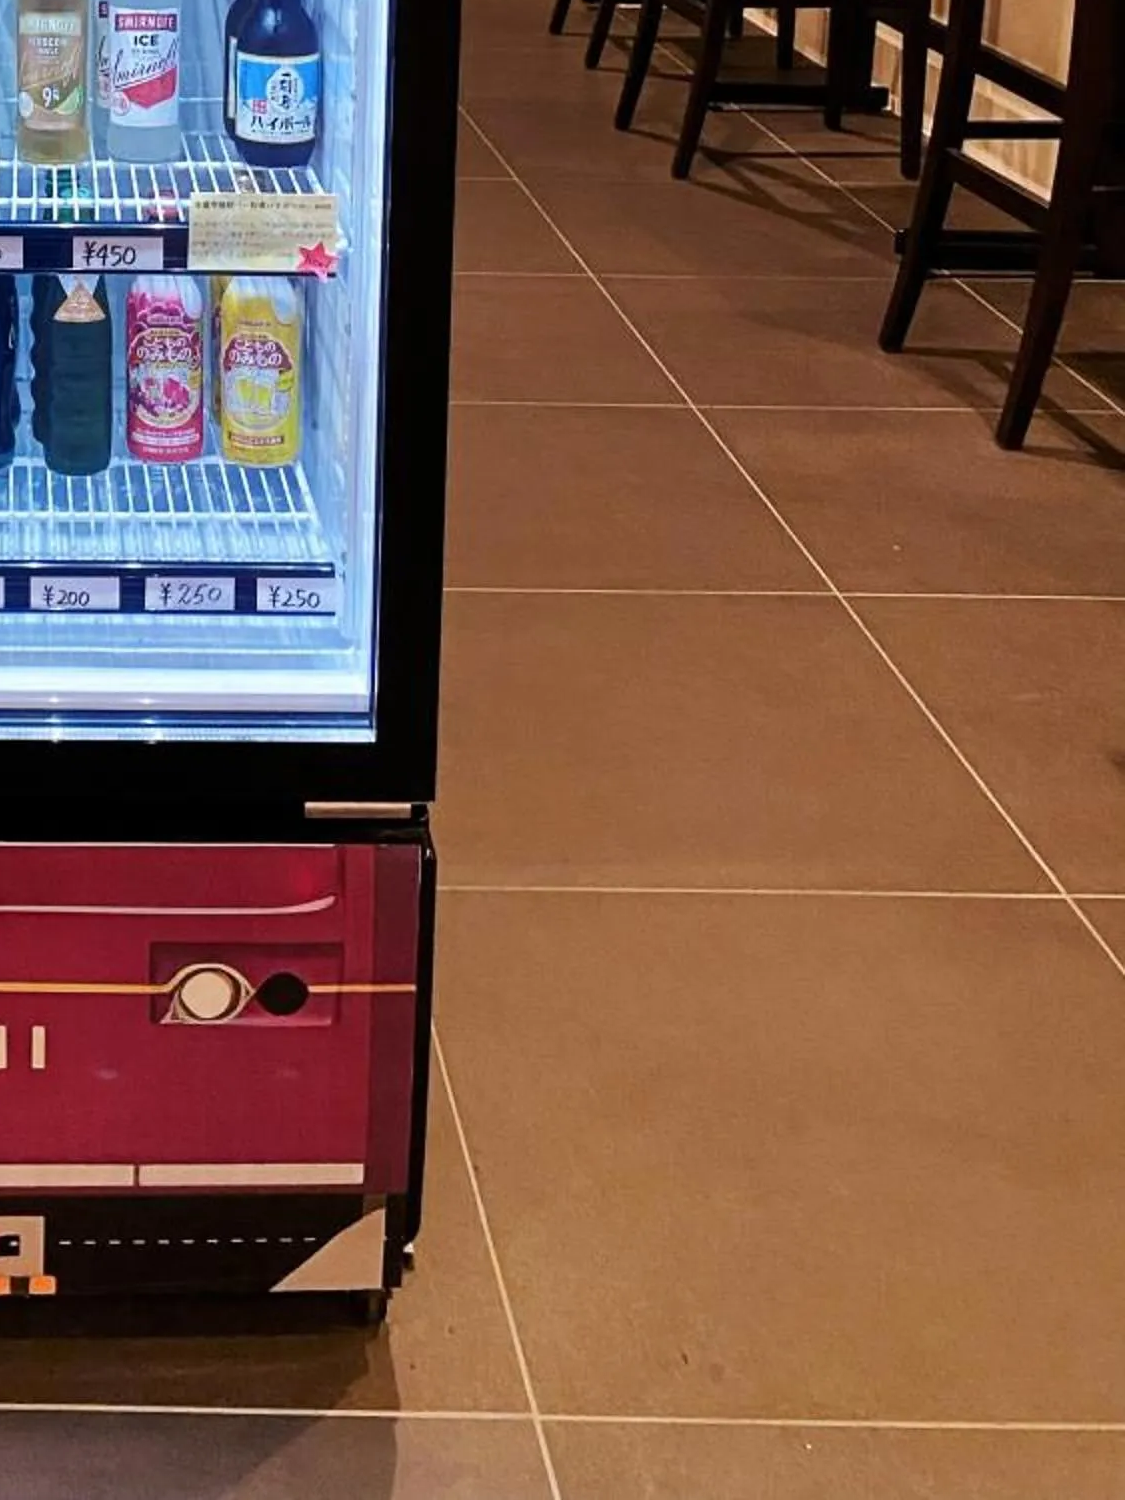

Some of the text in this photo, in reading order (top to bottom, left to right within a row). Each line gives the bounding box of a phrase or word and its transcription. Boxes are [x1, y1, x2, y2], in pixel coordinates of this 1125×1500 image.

[134, 35, 158, 47] ICE
[251, 115, 311, 131] ハイボール
[83, 241, 136, 266] ¥450
[42, 585, 90, 608] ¥200
[160, 583, 222, 605] ¥250
[269, 586, 321, 609] ¥250
